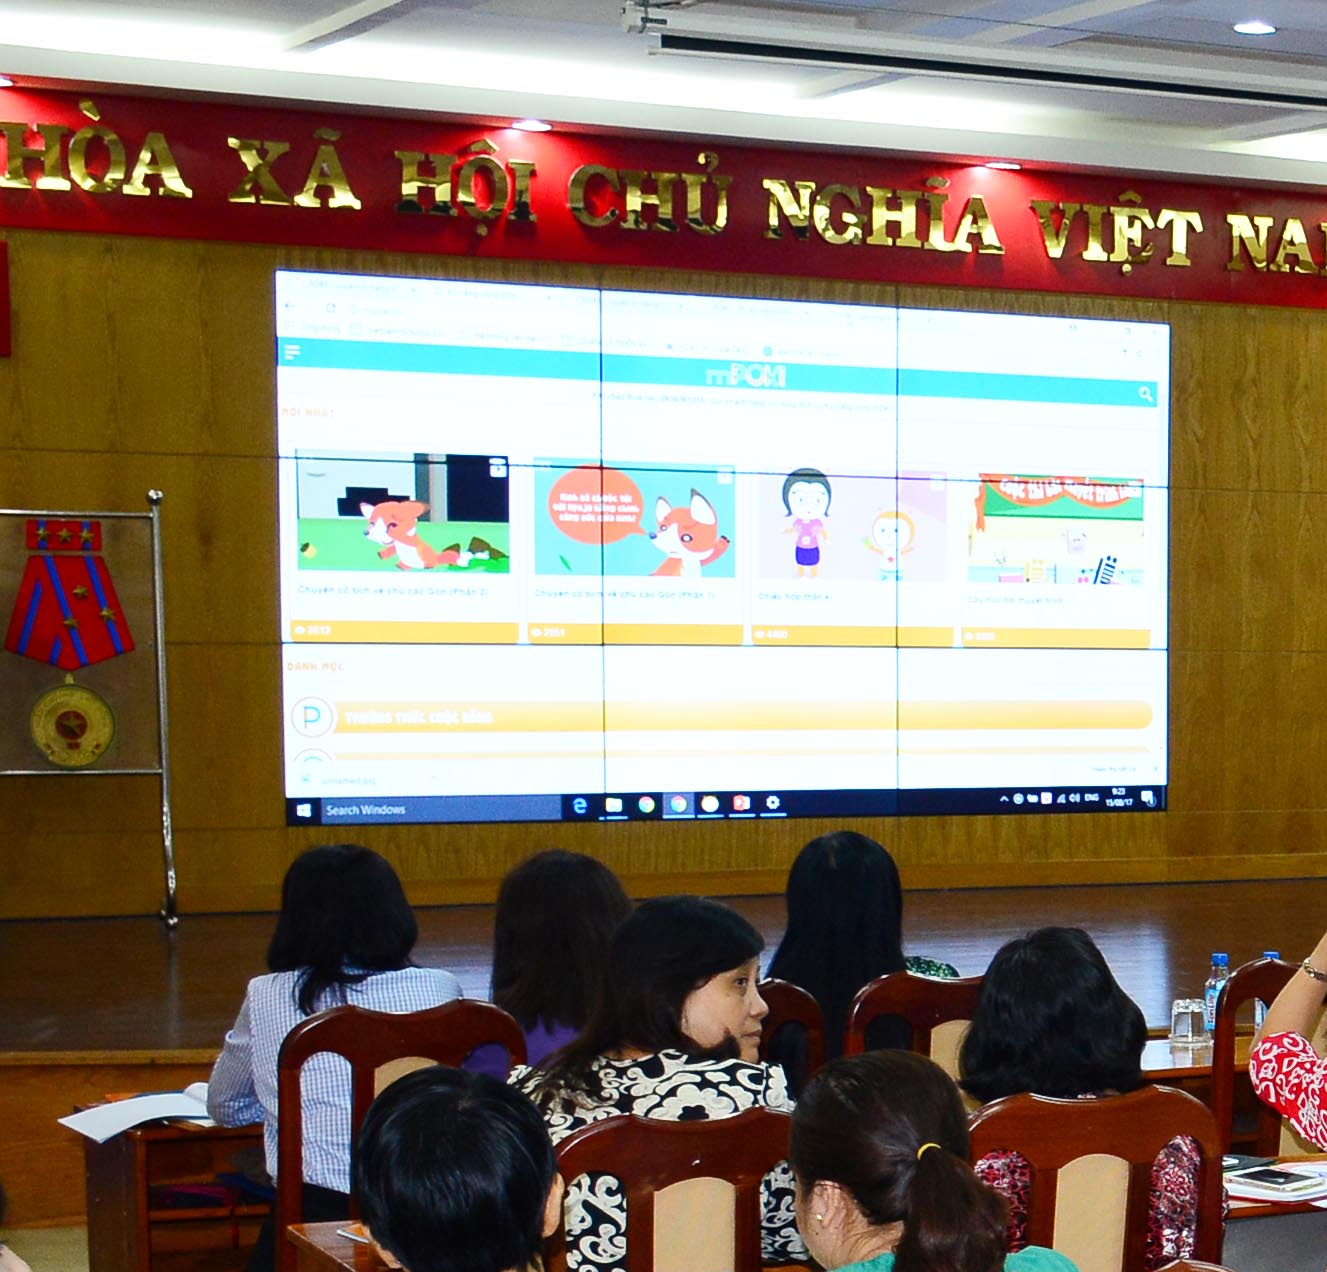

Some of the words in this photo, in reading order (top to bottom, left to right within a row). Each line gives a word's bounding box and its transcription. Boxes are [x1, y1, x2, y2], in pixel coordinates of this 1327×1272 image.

[0, 98, 193, 199] HÒA
[228, 127, 362, 210] XÃ
[394, 137, 538, 237] HỘI
[567, 151, 730, 235] CHỦ
[764, 178, 1005, 257] NGHĨA
[1031, 190, 1204, 278] VIỆT
[326, 804, 359, 817] Search
[361, 803, 406, 816] Windows
